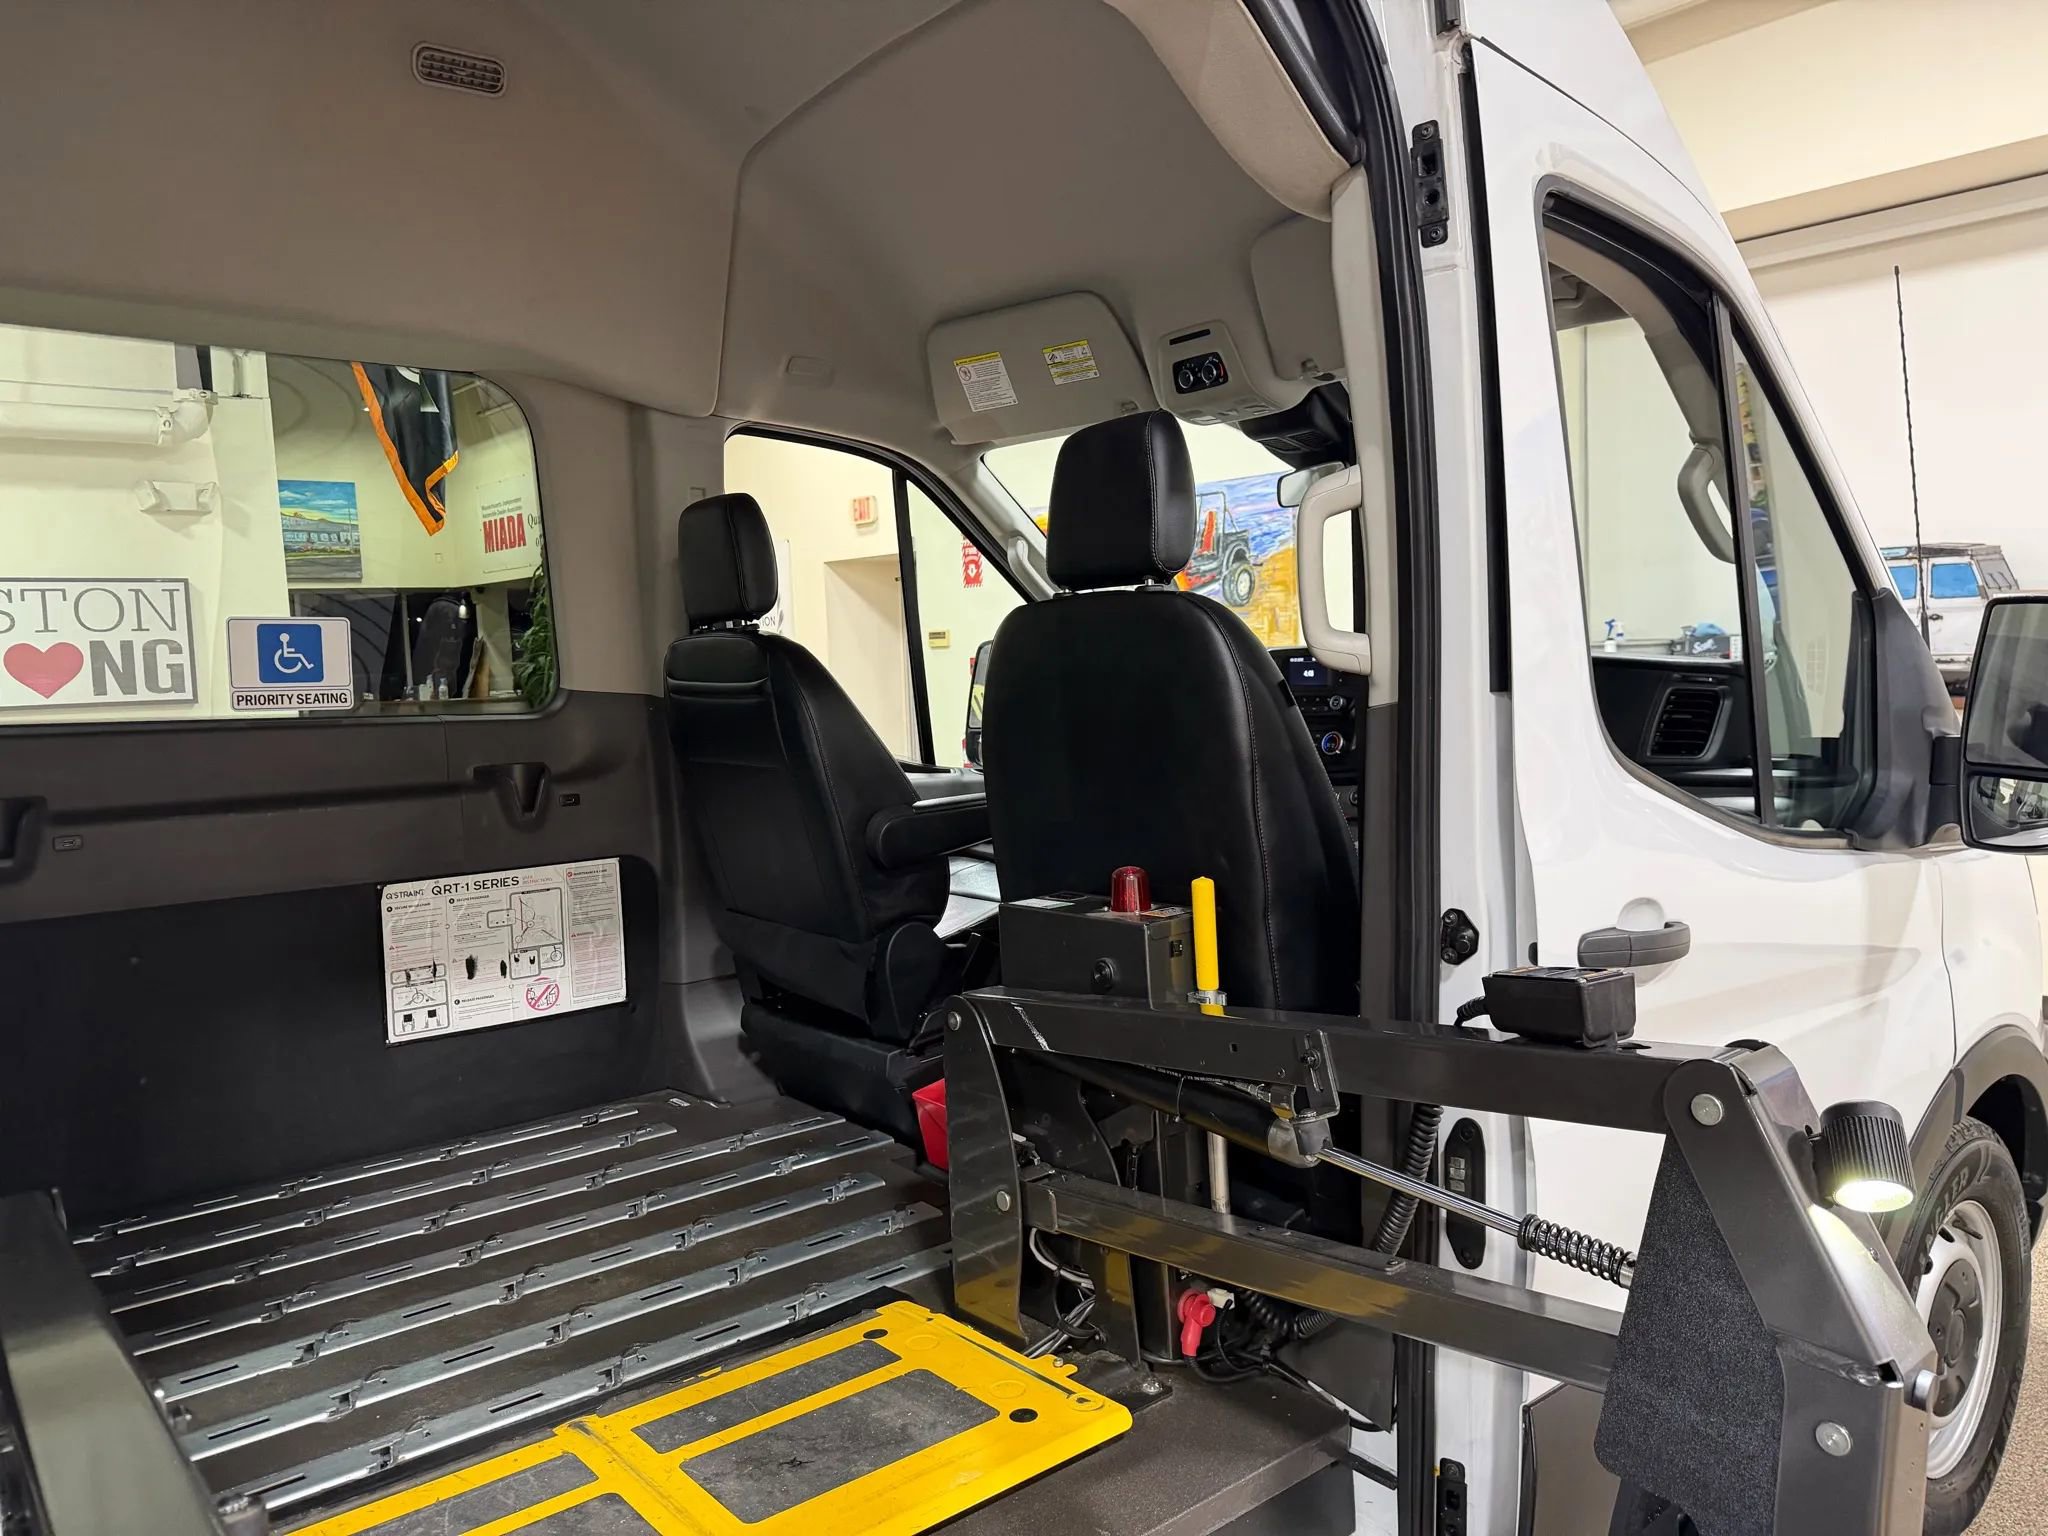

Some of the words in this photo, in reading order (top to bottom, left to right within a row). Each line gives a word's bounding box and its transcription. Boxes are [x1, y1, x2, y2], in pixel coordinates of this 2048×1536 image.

[853, 497, 870, 521] EXIT
[483, 513, 527, 553] MIADA
[89, 639, 186, 696] NG
[236, 694, 294, 706] PRIORITY
[296, 692, 348, 704] SEATING
[385, 889, 425, 900] Q'STRAINT
[431, 882, 469, 896] QRT-1
[473, 876, 520, 891] SERIES
